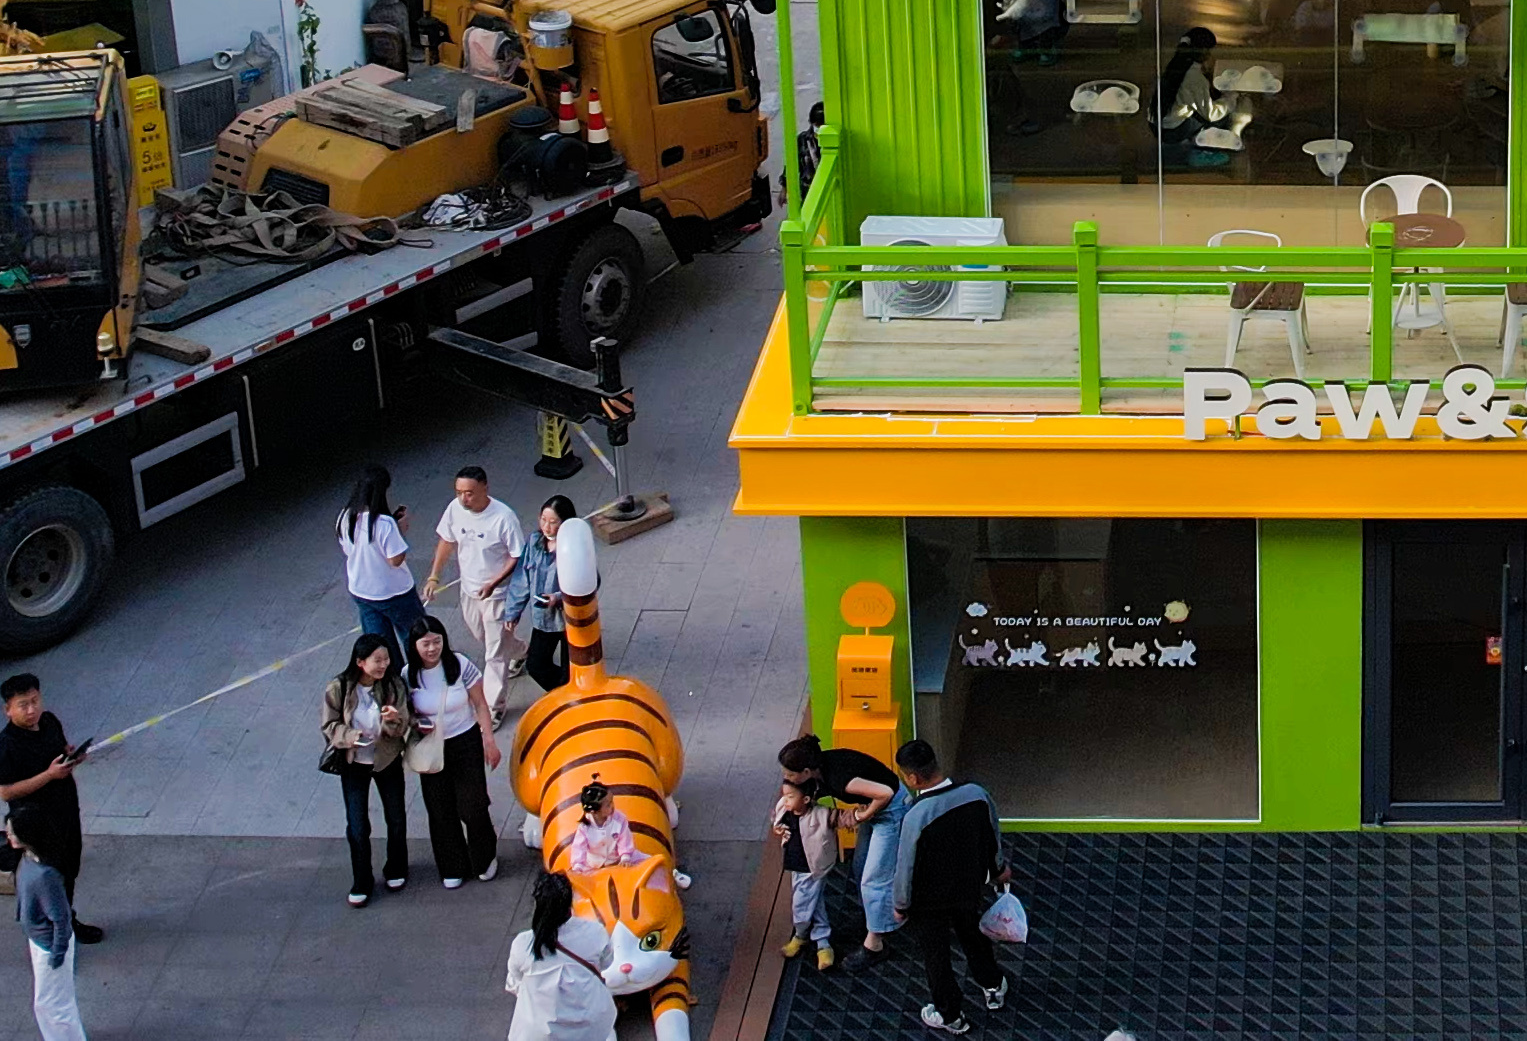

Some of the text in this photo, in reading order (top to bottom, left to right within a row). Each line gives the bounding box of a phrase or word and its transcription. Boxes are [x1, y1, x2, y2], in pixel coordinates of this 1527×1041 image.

[993, 617, 1162, 626] TODAY IS A BEAUTIFUL DAY
